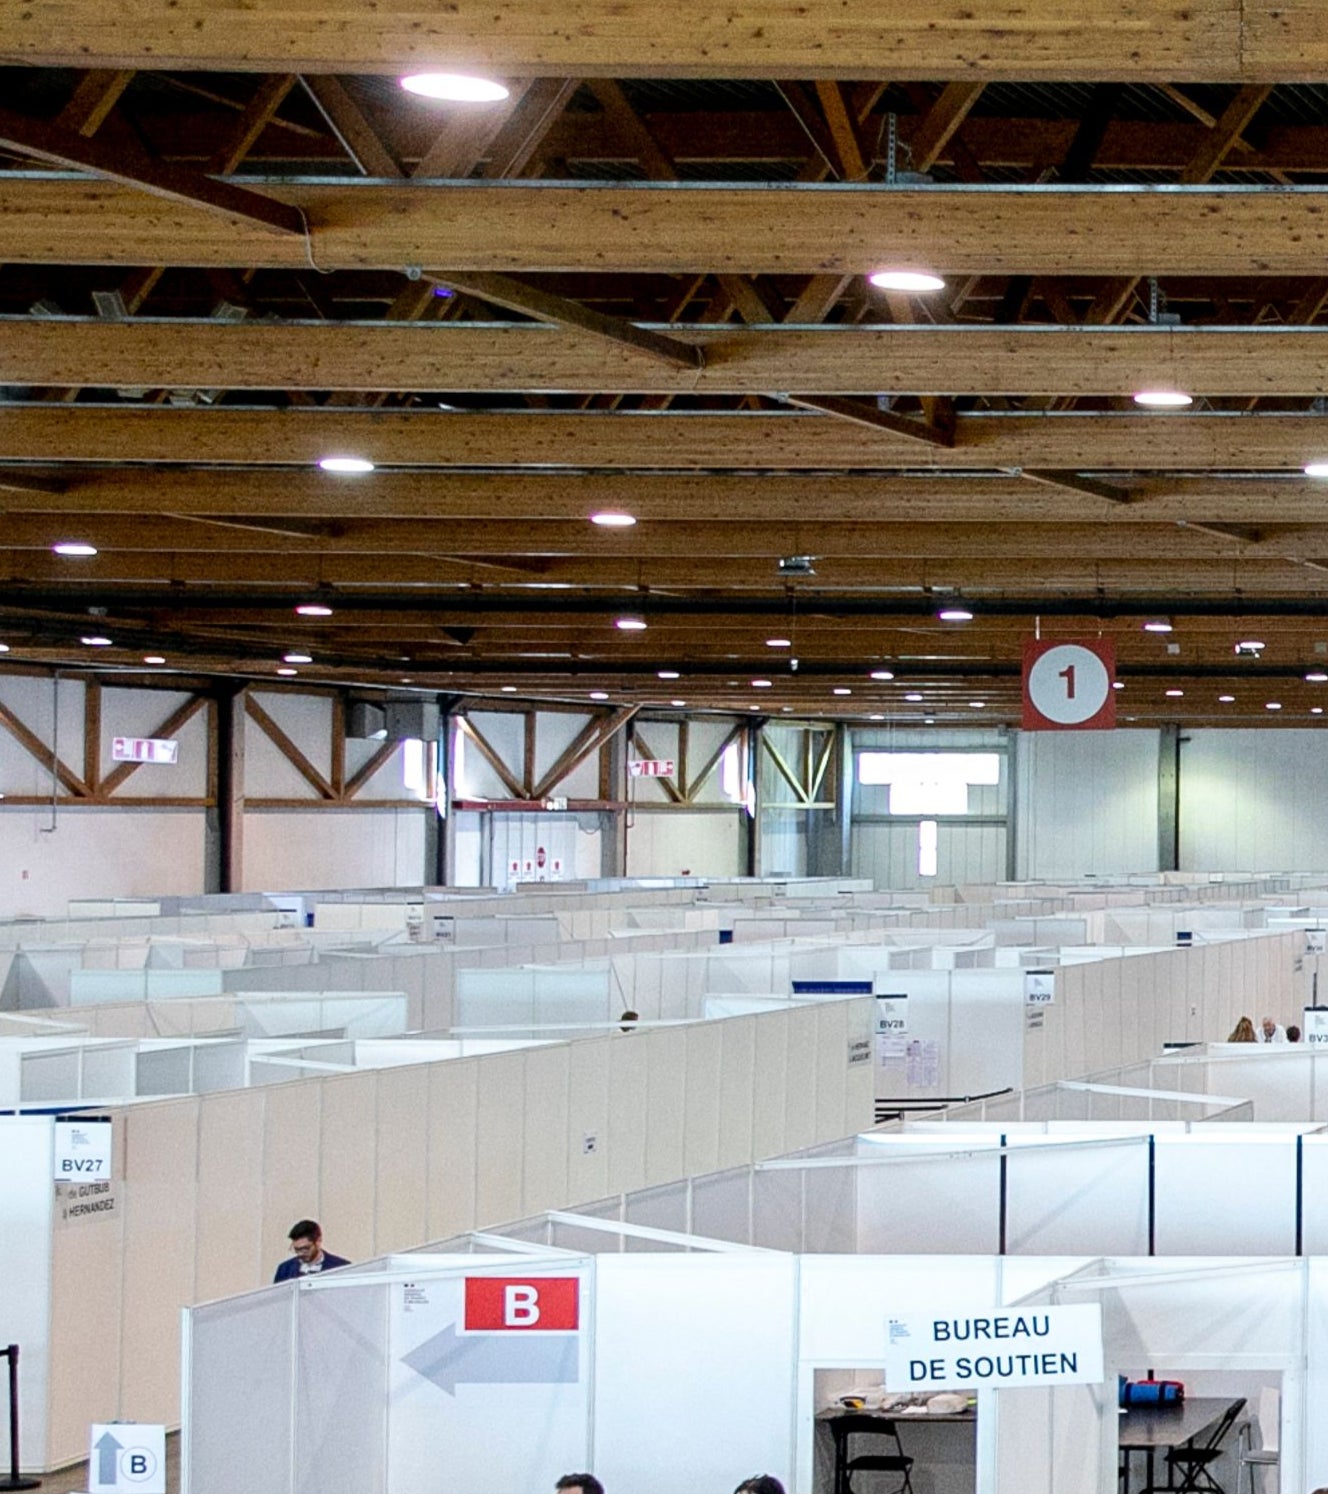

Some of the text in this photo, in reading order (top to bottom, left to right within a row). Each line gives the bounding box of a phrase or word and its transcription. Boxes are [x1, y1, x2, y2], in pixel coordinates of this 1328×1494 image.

[1058, 664, 1076, 699] 1
[61, 1158, 104, 1173] BV27
[69, 1197, 116, 1218] HERNANDEZ
[503, 1283, 541, 1328] B
[933, 1315, 1050, 1342] BUREAU
[909, 1351, 1078, 1382] DE SOUTIEN
[130, 1454, 148, 1475] B
